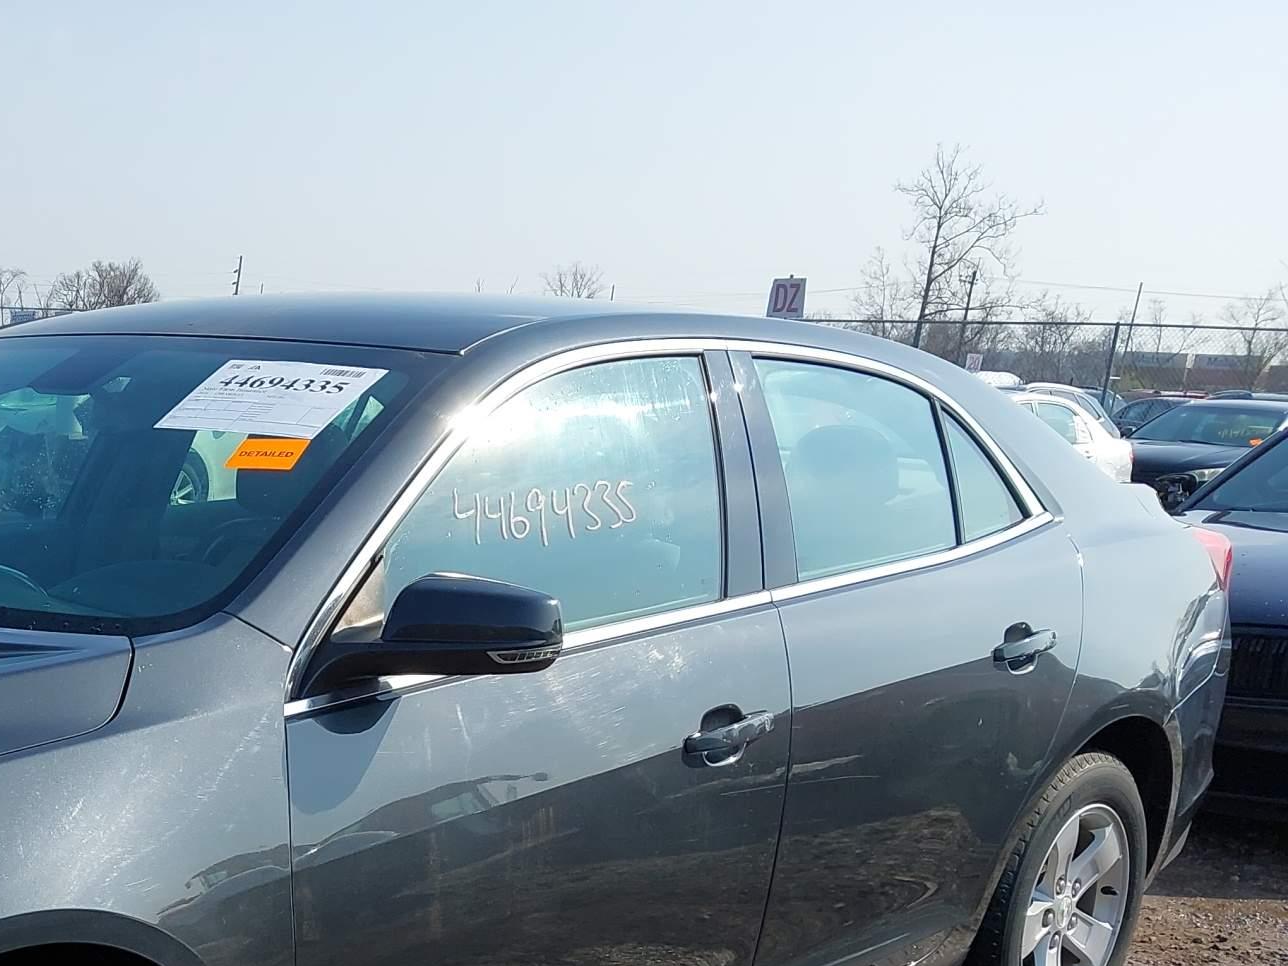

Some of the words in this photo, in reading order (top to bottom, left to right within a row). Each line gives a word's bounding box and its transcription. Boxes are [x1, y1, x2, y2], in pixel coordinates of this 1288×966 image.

[772, 283, 801, 313] DZ
[220, 374, 350, 394] 44694335
[452, 480, 637, 547] 44694335
